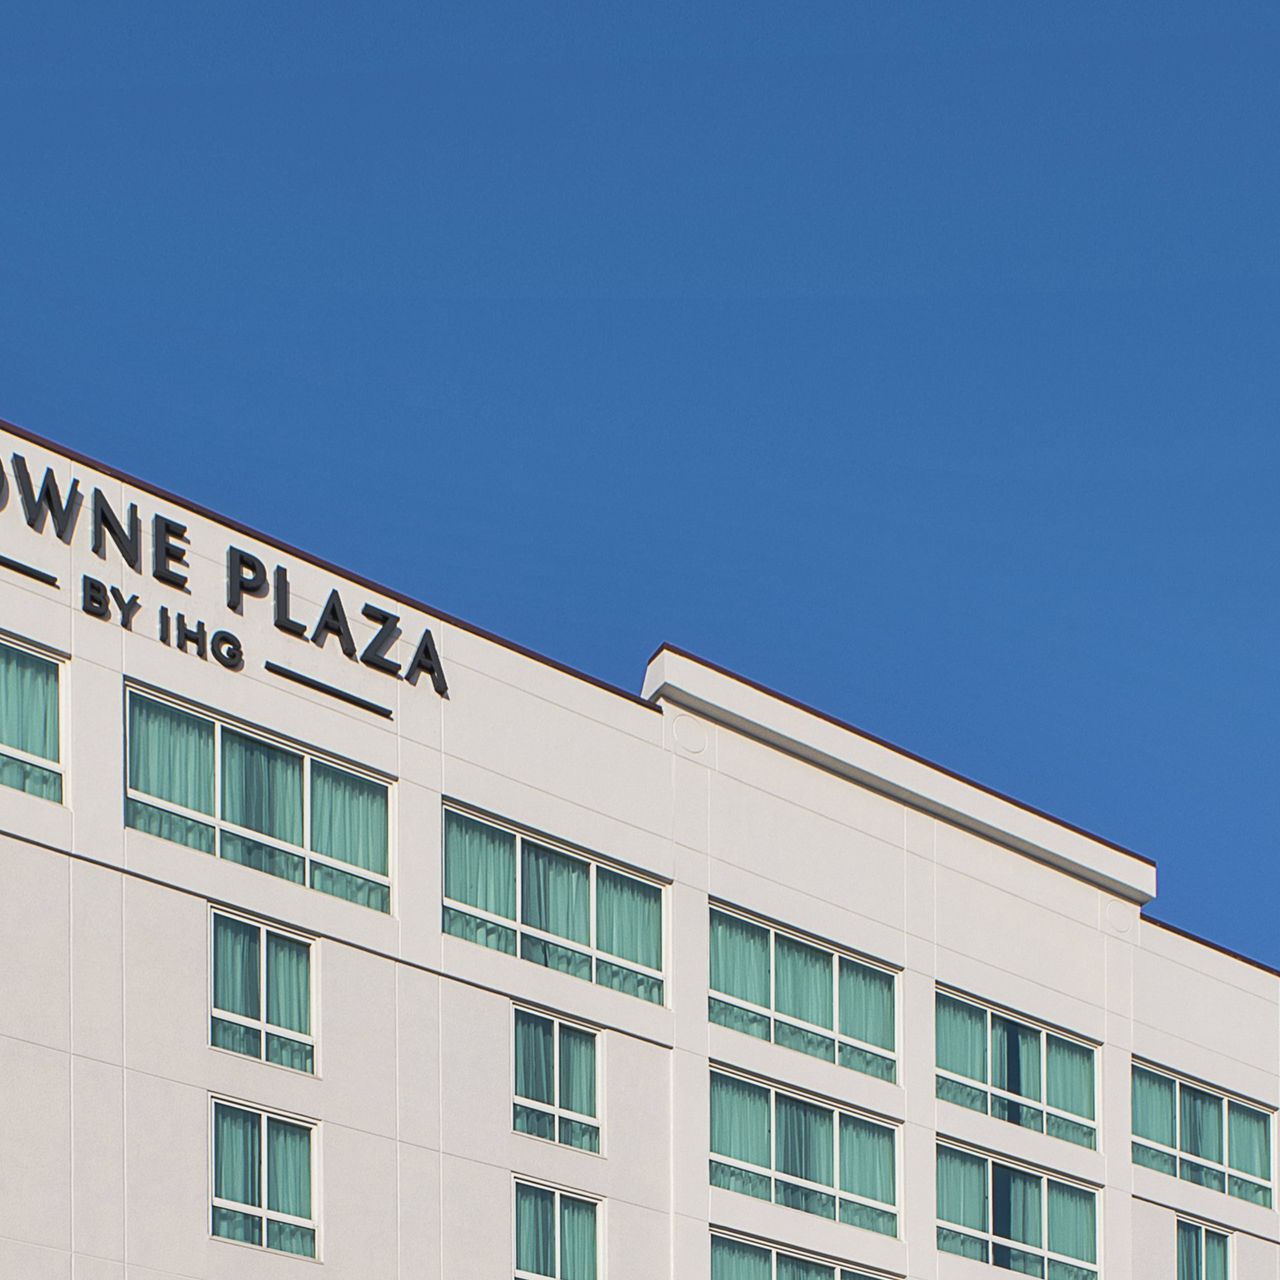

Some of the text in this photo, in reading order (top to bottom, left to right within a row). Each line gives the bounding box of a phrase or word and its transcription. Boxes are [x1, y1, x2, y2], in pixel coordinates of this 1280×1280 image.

[81, 573, 246, 669] BY IHG
[227, 545, 450, 697] PLAZA
